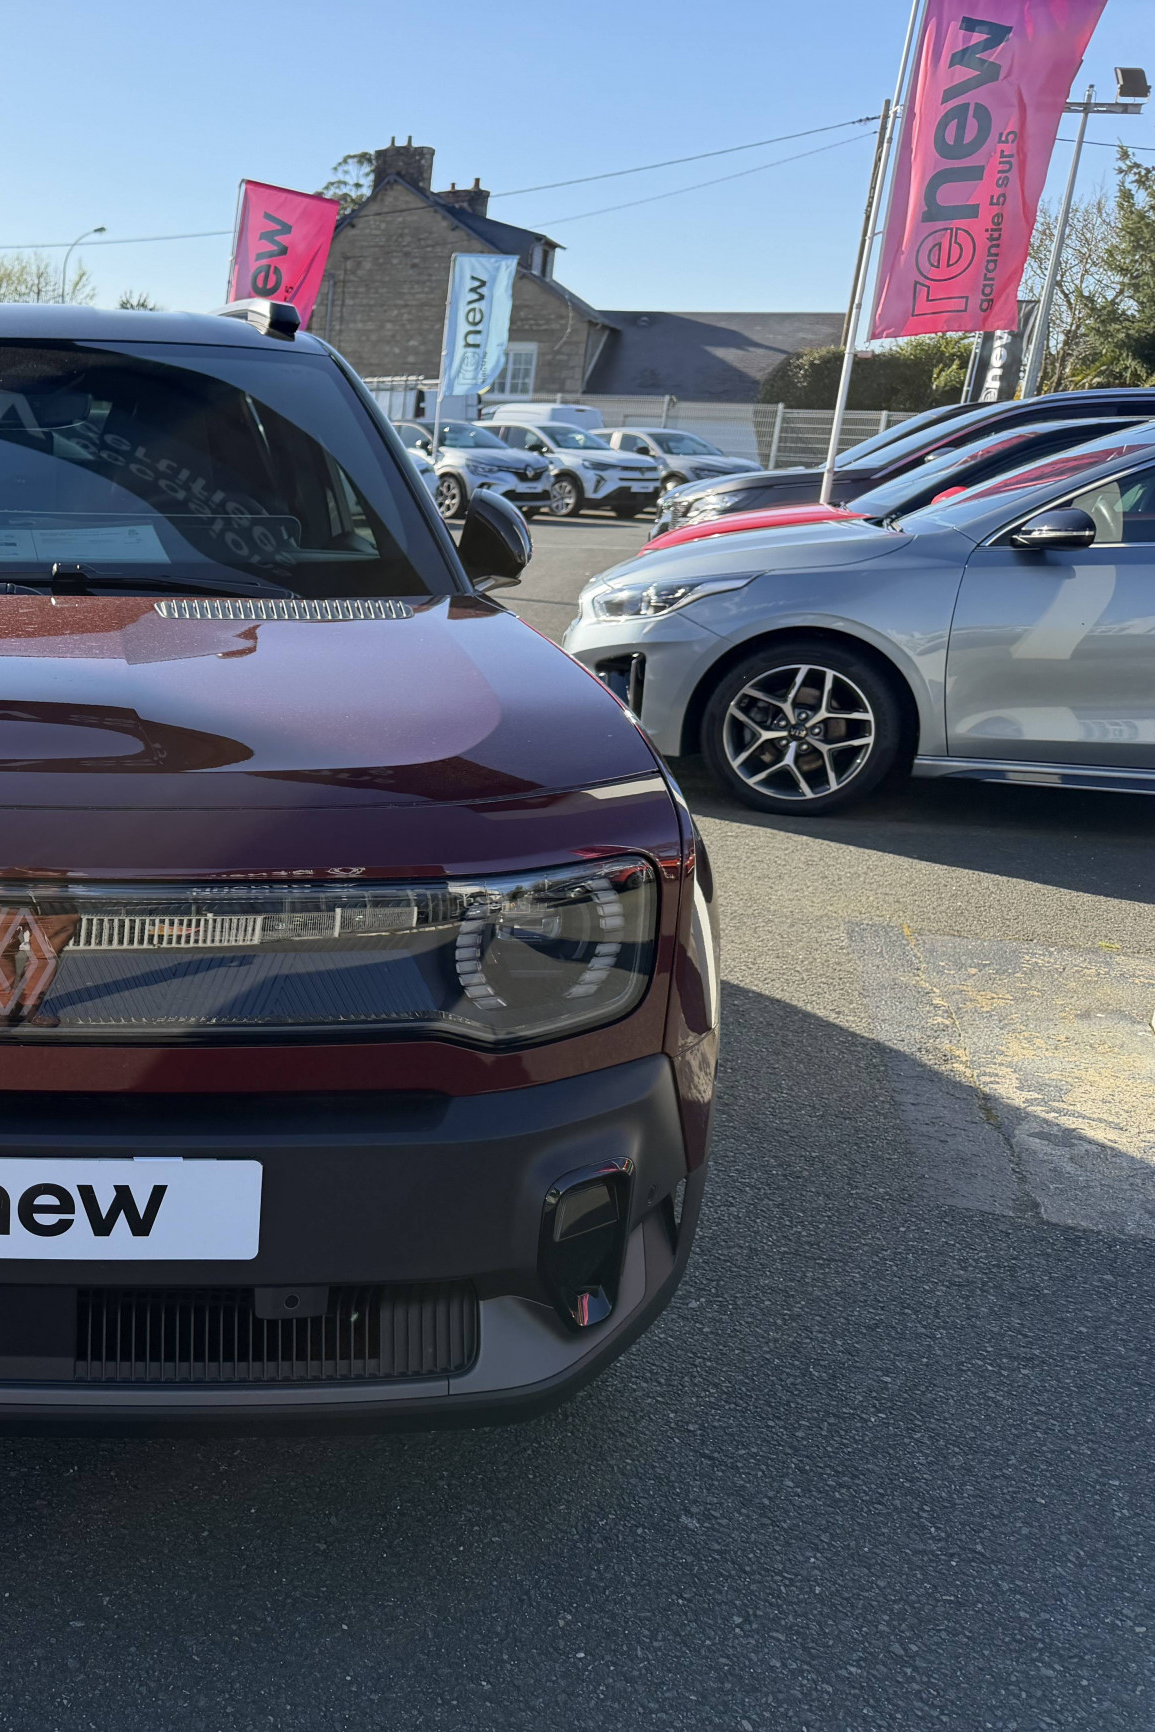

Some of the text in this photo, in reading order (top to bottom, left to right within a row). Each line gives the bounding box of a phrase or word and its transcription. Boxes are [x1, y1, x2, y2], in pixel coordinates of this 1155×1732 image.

[912, 16, 1013, 317] renew
[978, 130, 1018, 313] garantie 5 sur 5
[457, 275, 487, 386] renew
